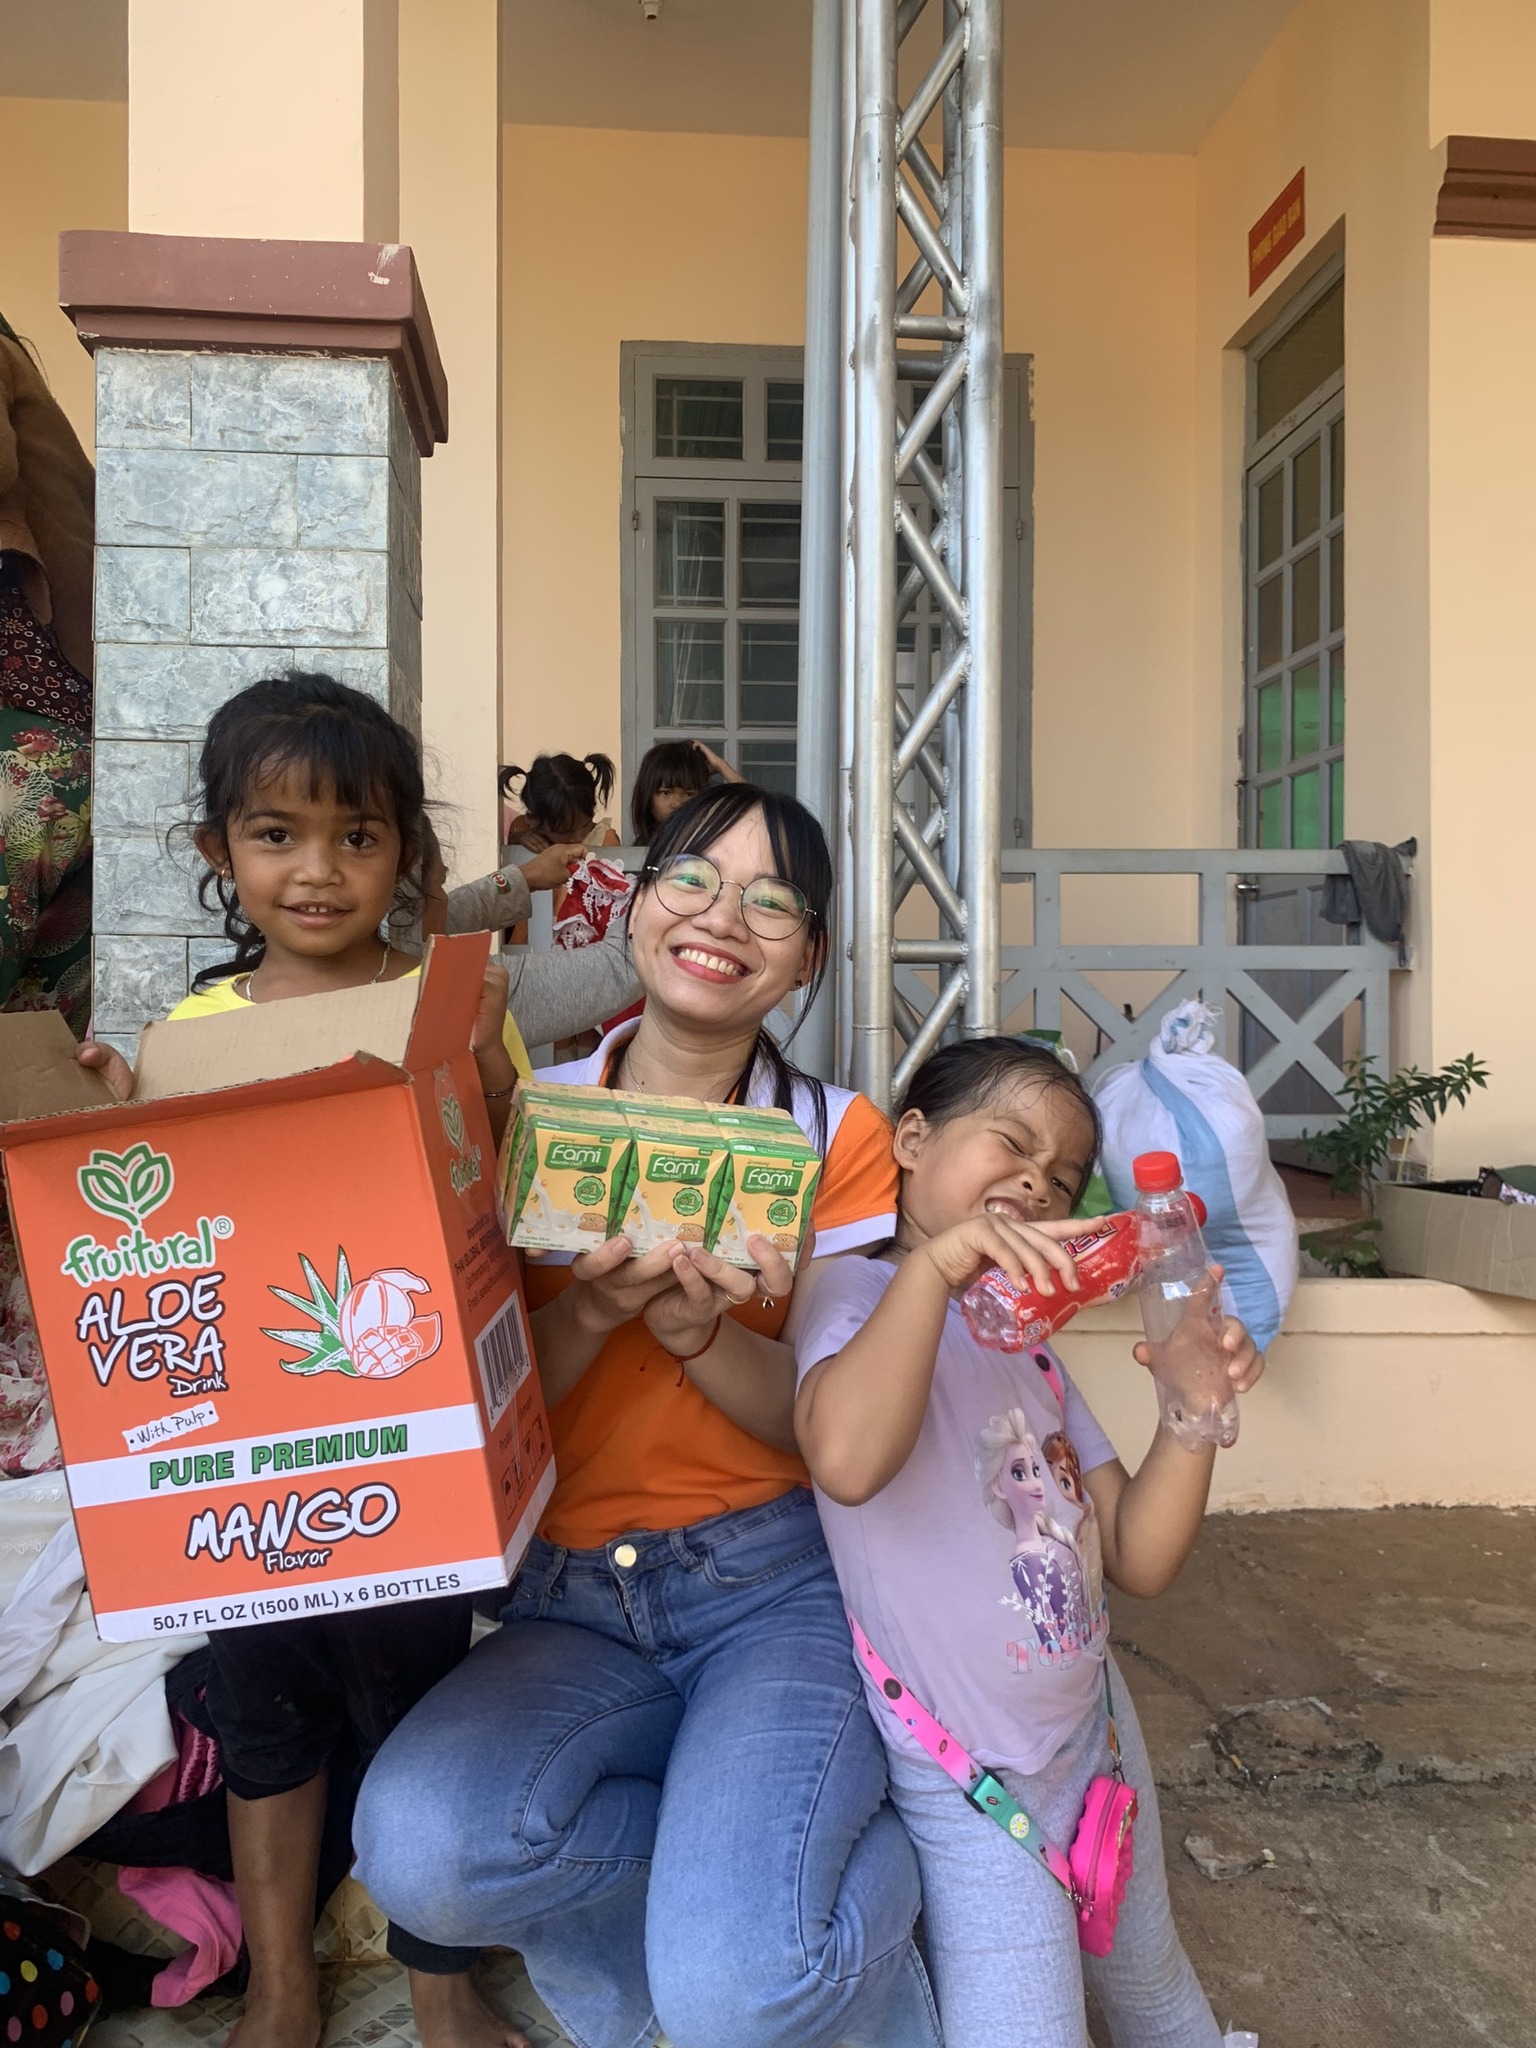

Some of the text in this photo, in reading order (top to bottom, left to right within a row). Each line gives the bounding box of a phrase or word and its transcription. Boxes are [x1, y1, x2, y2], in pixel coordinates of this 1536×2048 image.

[76, 1273, 225, 1343] ALOE
[89, 1325, 225, 1386] VERA
[170, 1374, 227, 1399] Drink
[137, 1410, 206, 1444] With Pulp
[149, 1424, 409, 1490] PURE PREMIUM
[186, 1482, 400, 1563] MANGO
[264, 1548, 330, 1573] Flavor
[153, 1613, 188, 1631] 50.7
[194, 1609, 217, 1626] FL
[220, 1604, 247, 1622] OZ
[251, 1596, 300, 1619] (1500
[304, 1590, 340, 1612] ML)
[358, 1587, 370, 1601] 6
[374, 1573, 461, 1599] BOTTLES
